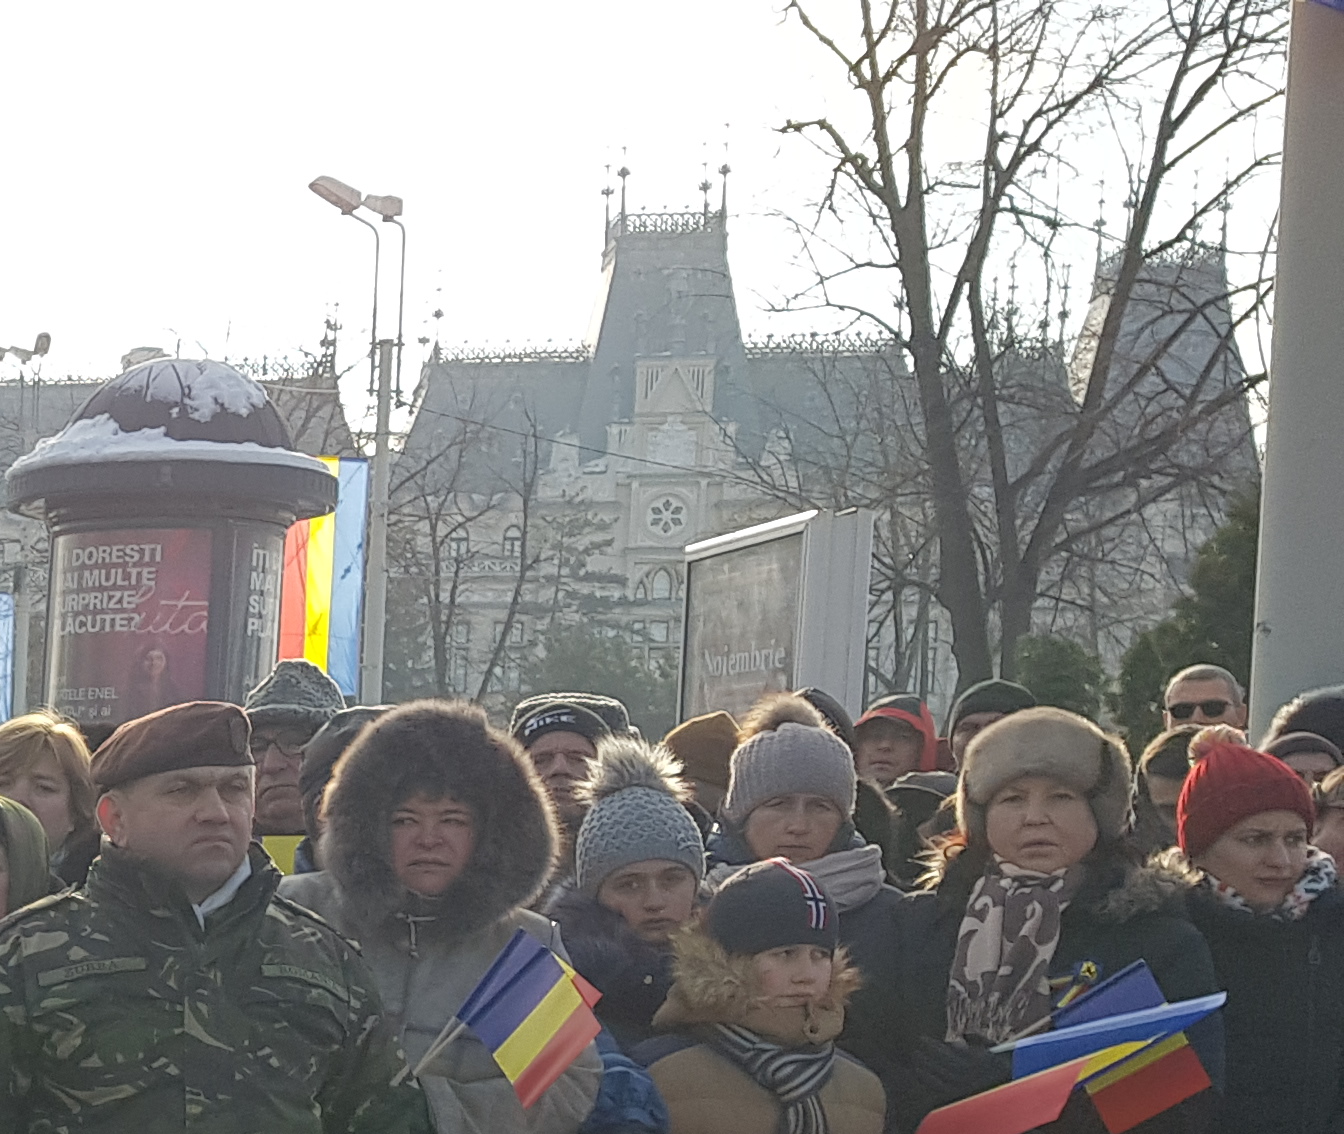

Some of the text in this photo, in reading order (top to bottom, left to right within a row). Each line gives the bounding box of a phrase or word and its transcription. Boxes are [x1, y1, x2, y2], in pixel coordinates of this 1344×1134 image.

[71, 543, 163, 568] DOREȘTI
[62, 569, 80, 589] AI
[60, 590, 137, 612] URPRIZE
[59, 612, 141, 635] LĂCUTE?
